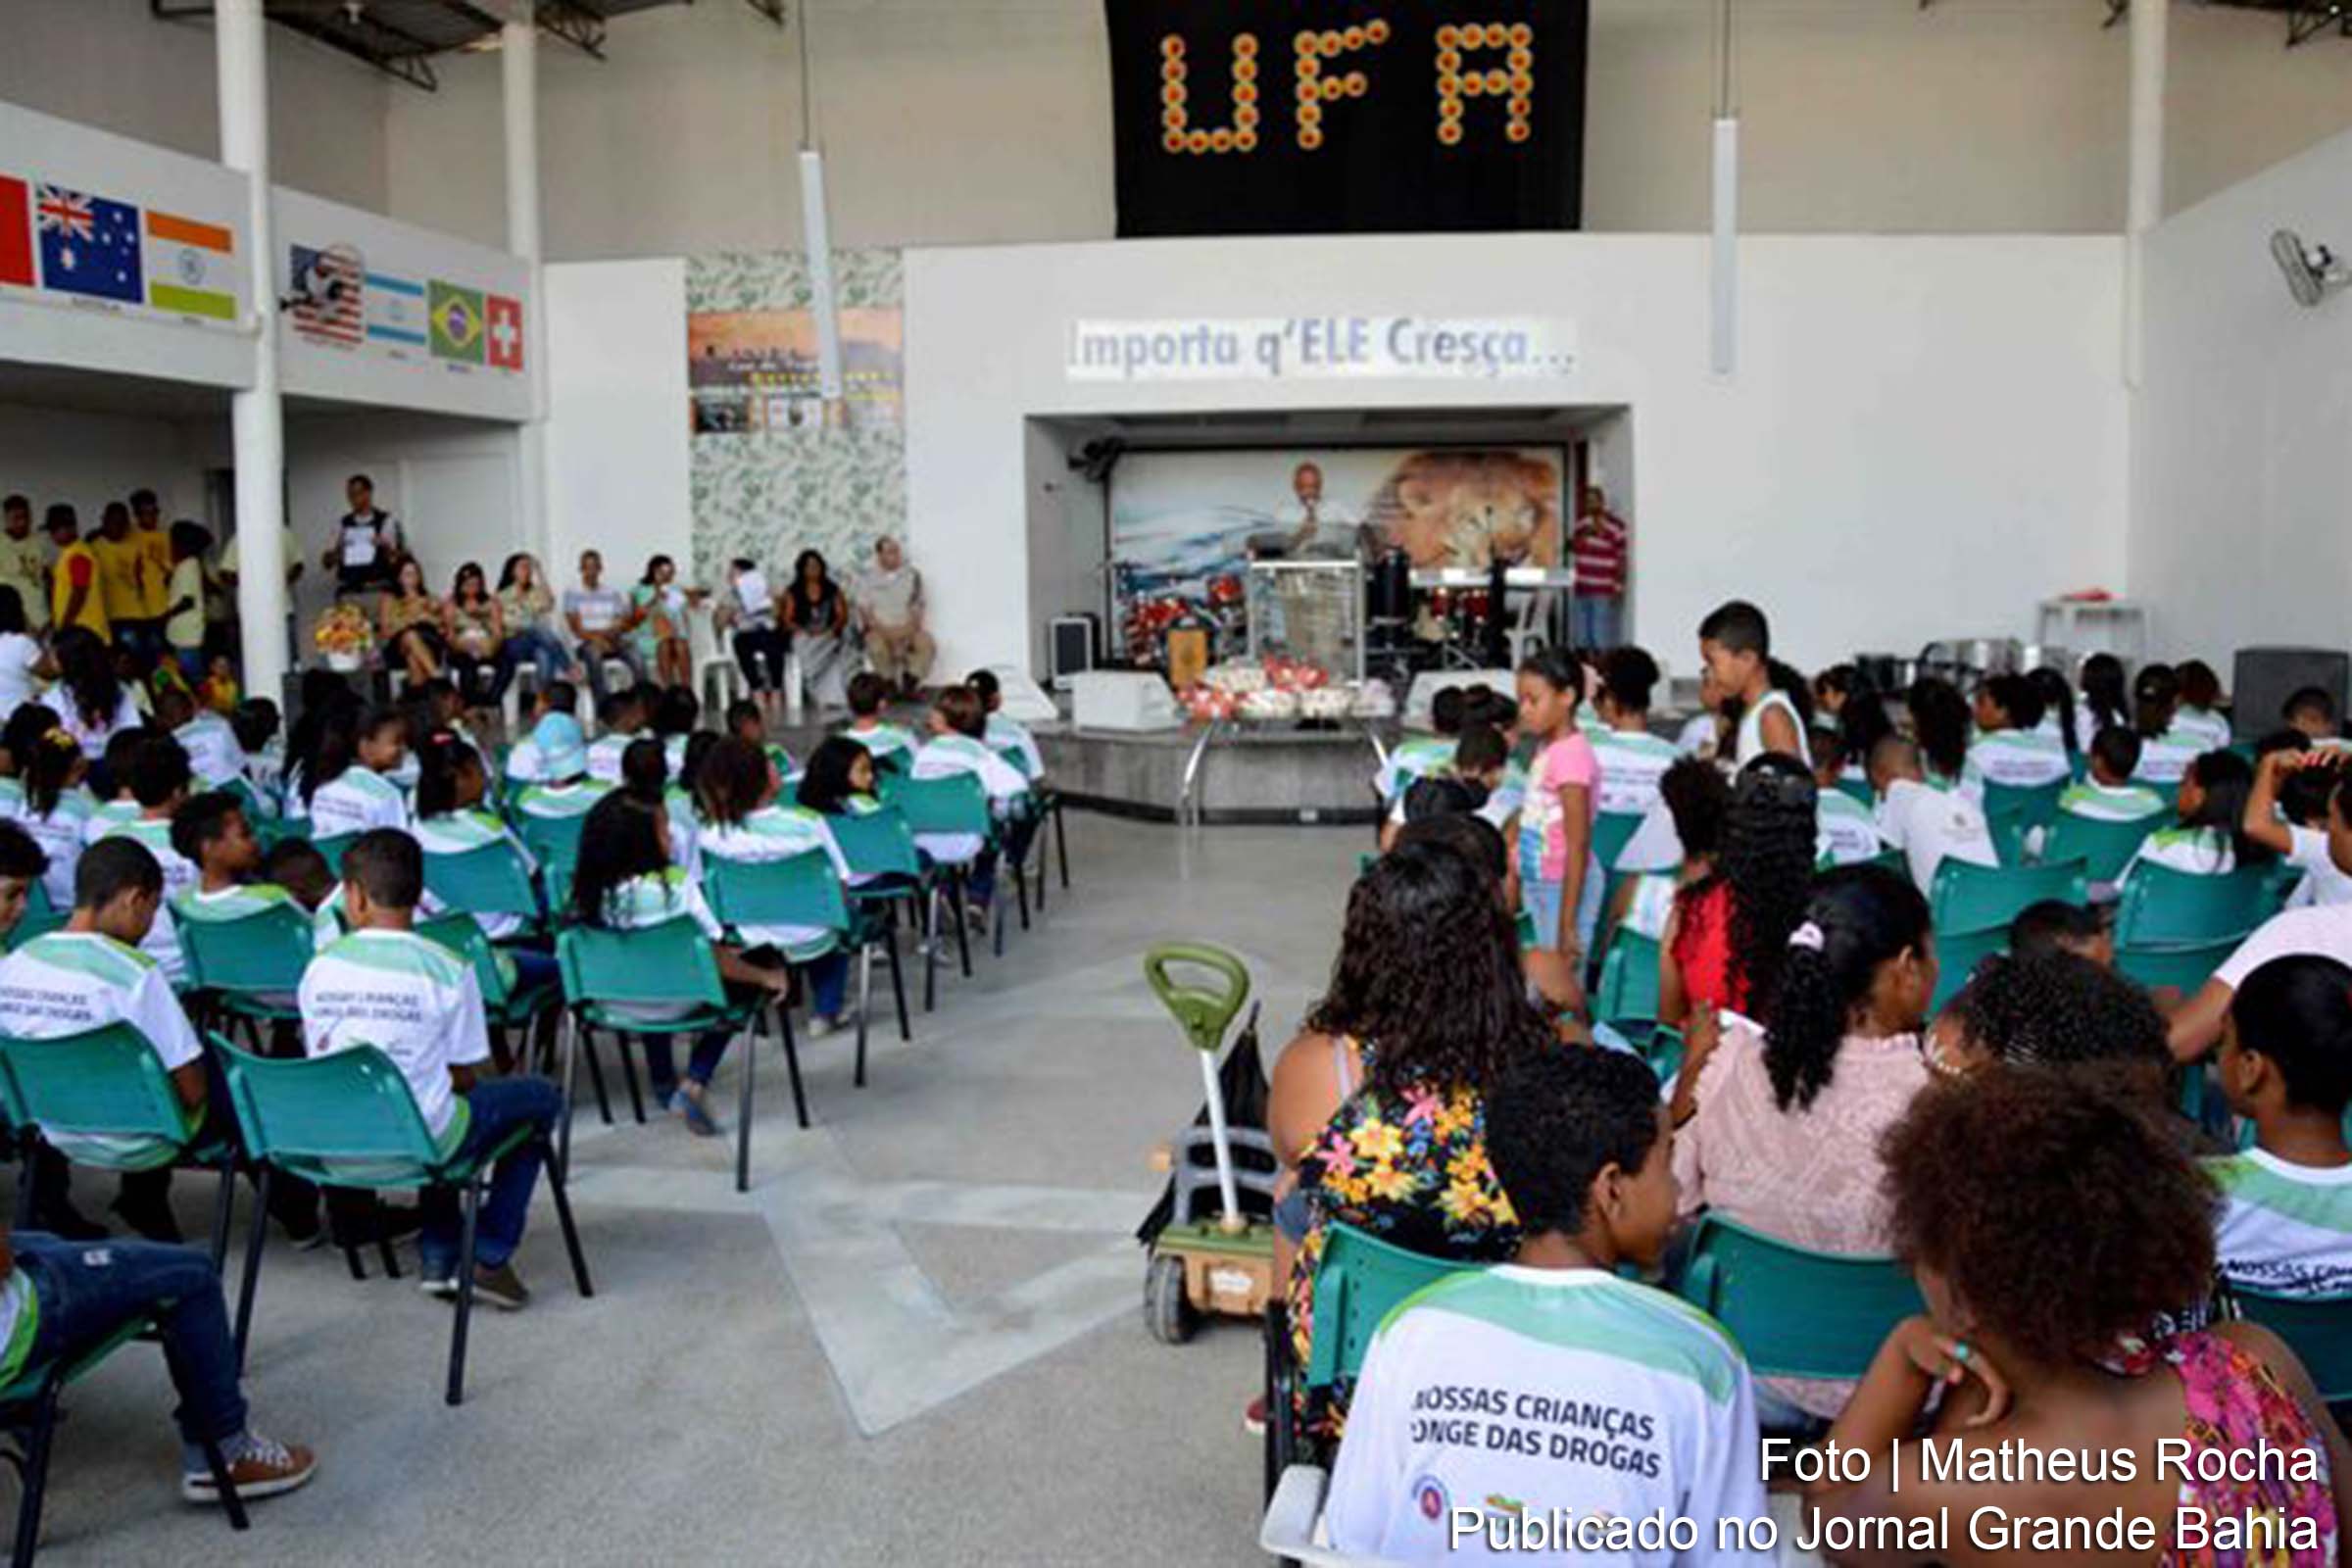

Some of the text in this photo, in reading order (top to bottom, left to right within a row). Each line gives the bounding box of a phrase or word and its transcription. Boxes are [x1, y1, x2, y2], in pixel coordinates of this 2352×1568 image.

[1068, 321, 1239, 376] Importa
[1514, 1393, 1655, 1442] CRIANÇAS
[1410, 1418, 1662, 1480] ONGE DAS DROGAS
